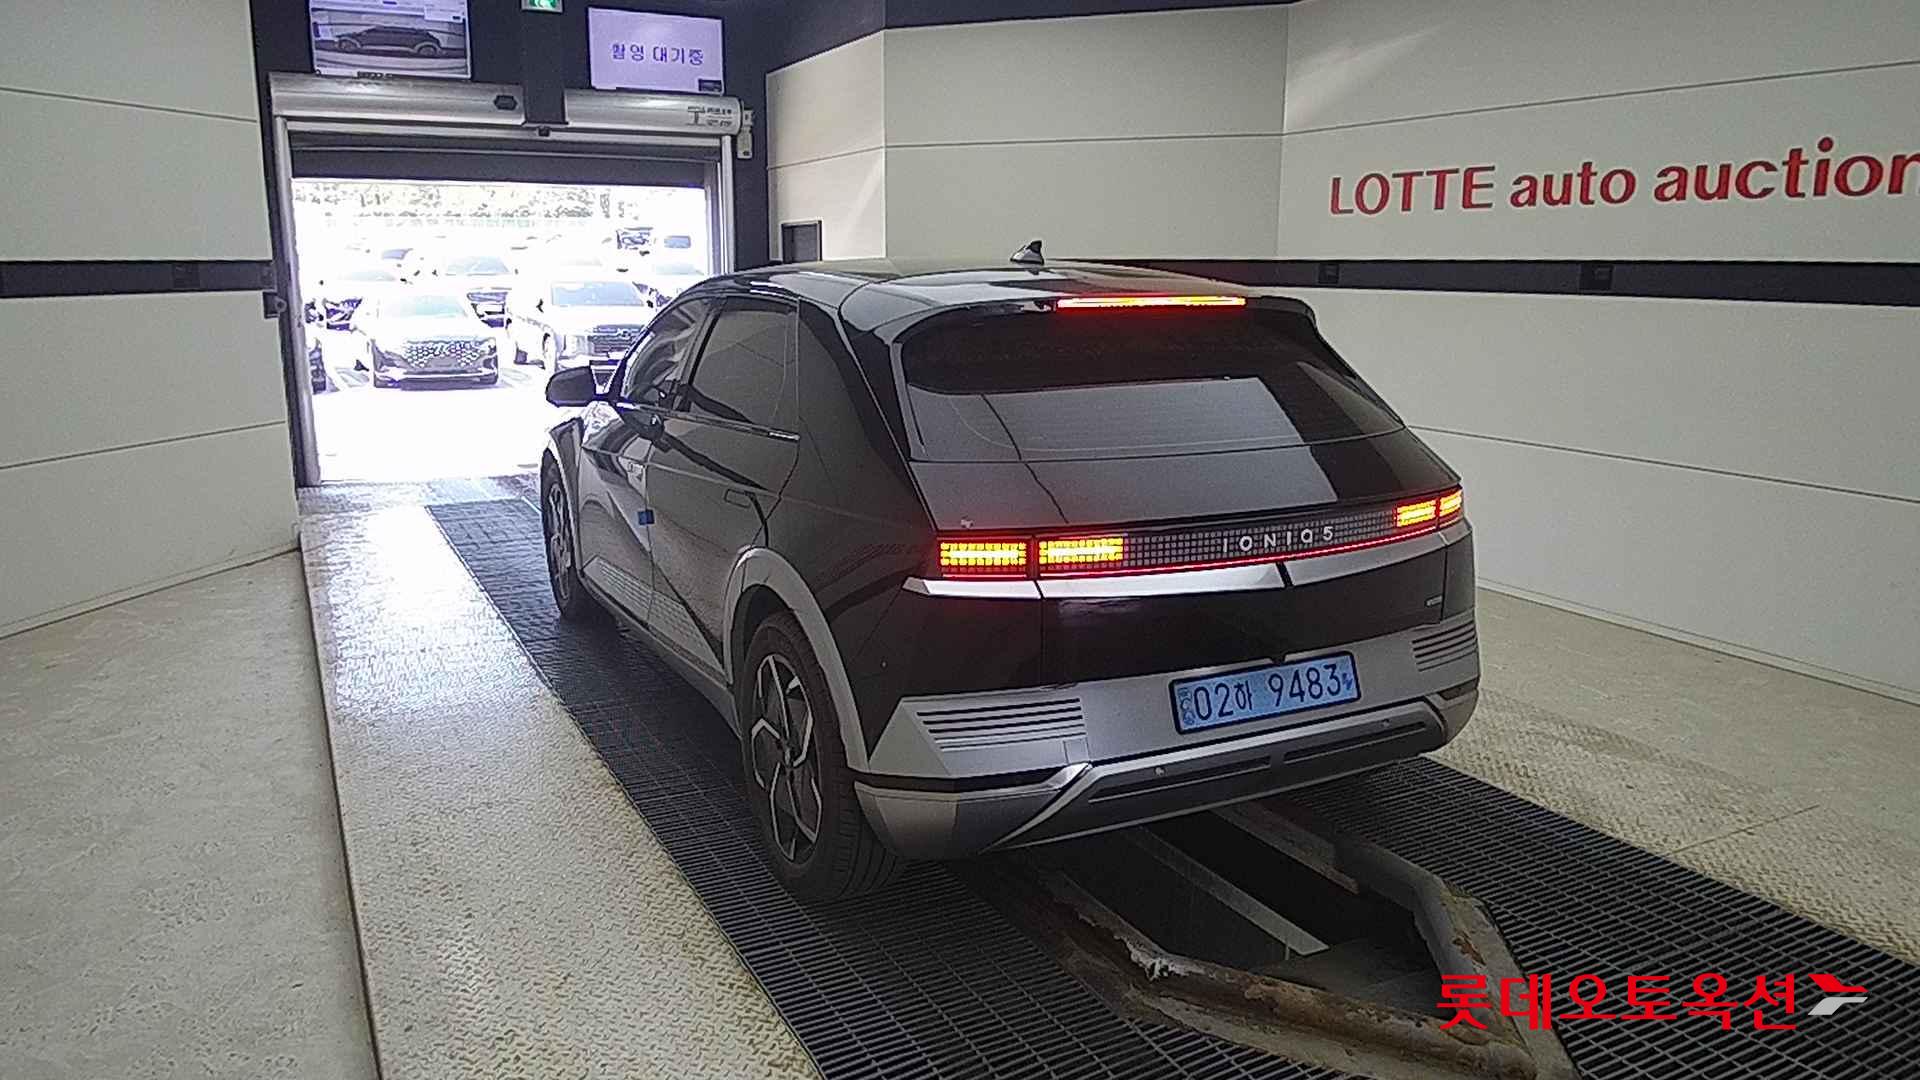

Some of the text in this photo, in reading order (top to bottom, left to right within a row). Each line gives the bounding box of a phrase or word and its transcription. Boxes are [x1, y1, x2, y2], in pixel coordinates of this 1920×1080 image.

[652, 45, 704, 66] 대기중
[1330, 166, 1496, 215] LOTTE
[1510, 161, 1637, 208] auto
[1193, 680, 1253, 721] 02하
[1268, 663, 1342, 707] 9483
